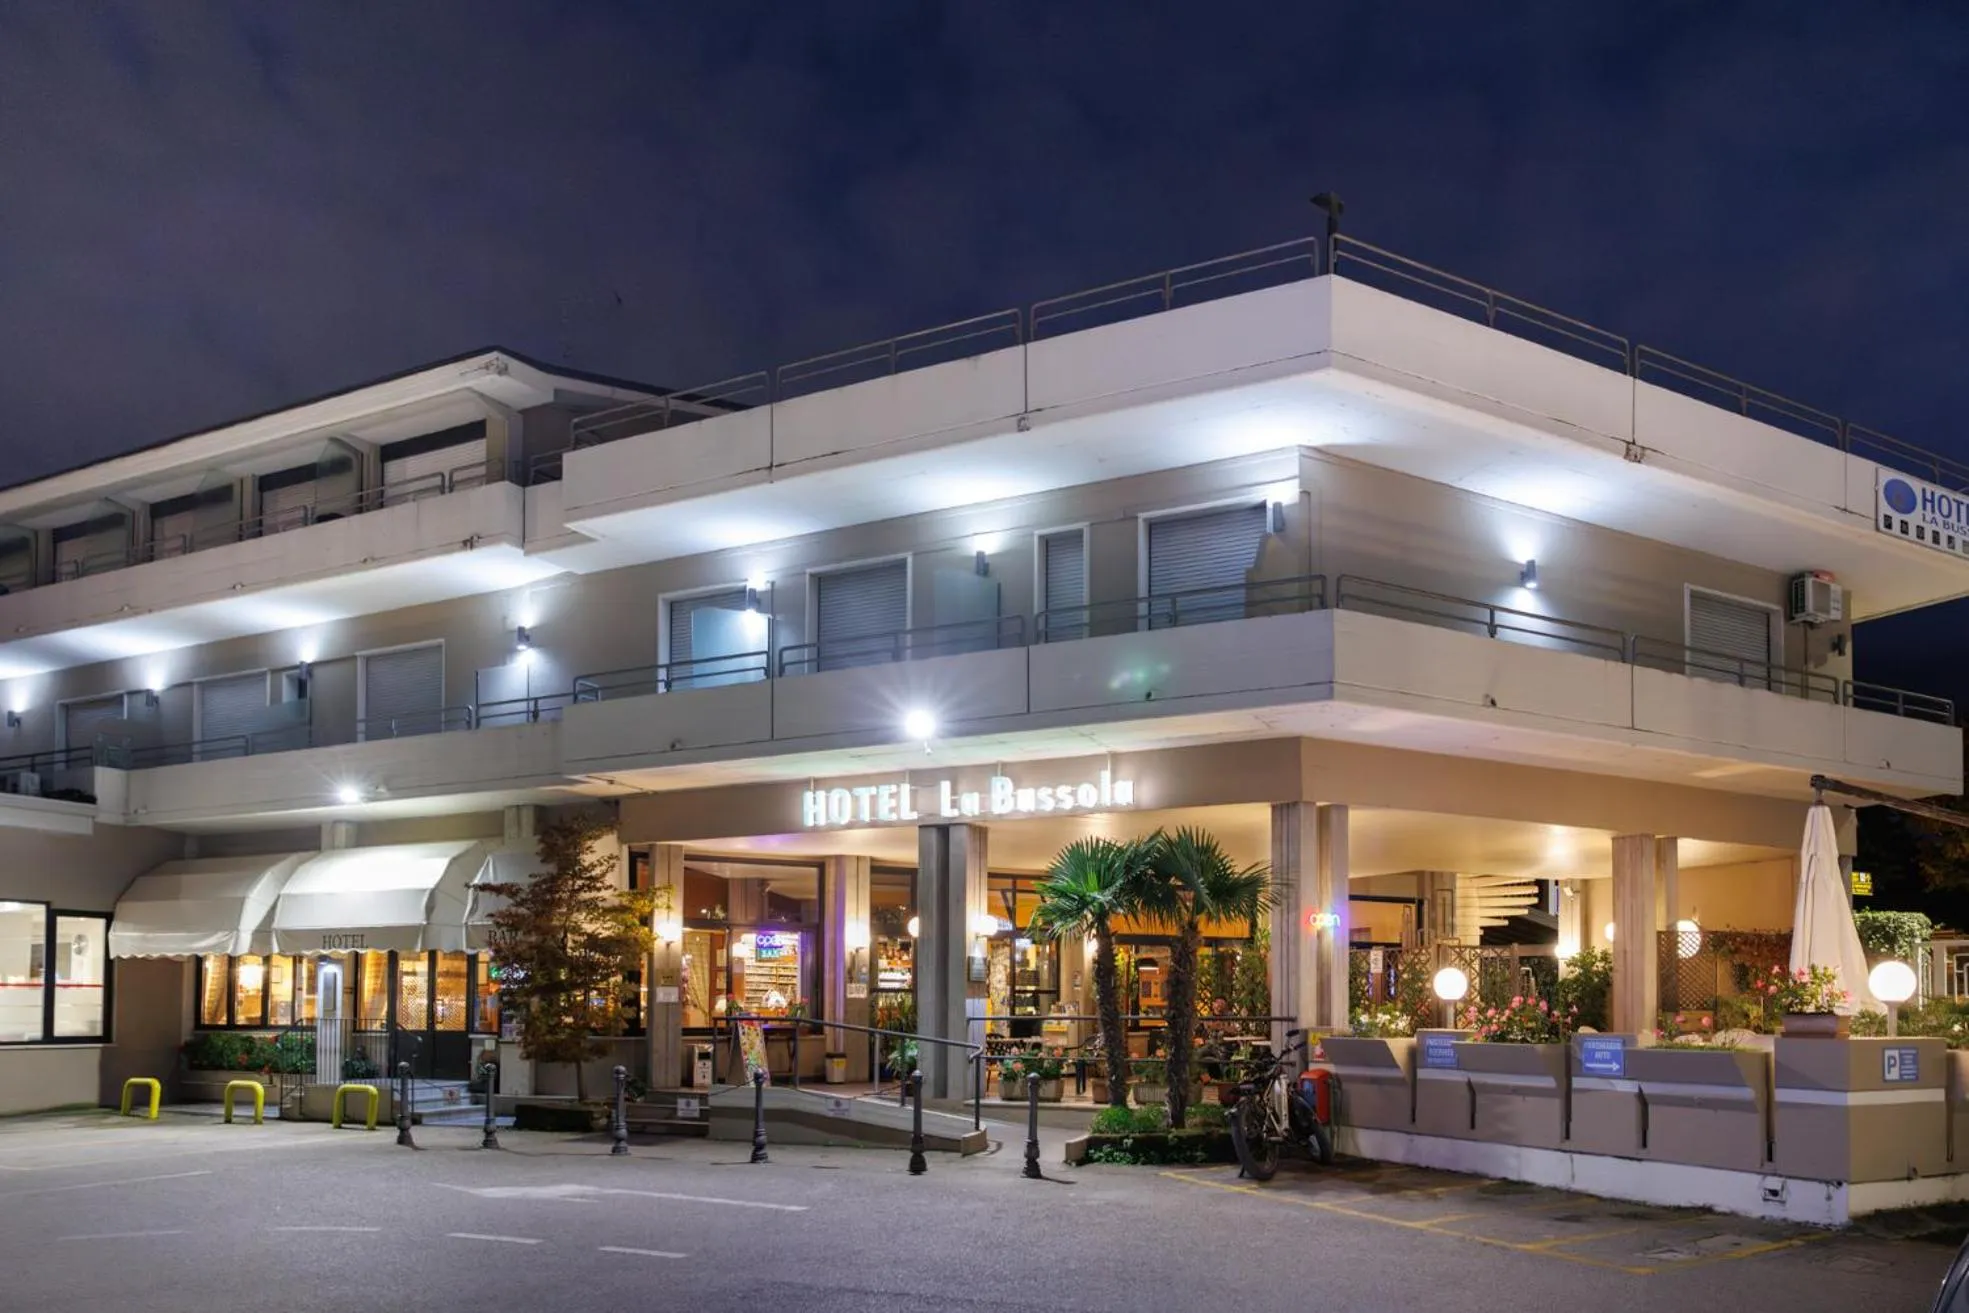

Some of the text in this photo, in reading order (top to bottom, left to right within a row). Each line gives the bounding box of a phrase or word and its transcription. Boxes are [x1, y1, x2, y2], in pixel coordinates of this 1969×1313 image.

[1922, 513, 1969, 536] LA BUS
[803, 769, 1135, 827] HOTEL La Bussola
[322, 934, 369, 949] HOTEL
[1887, 1055, 1898, 1075] P
